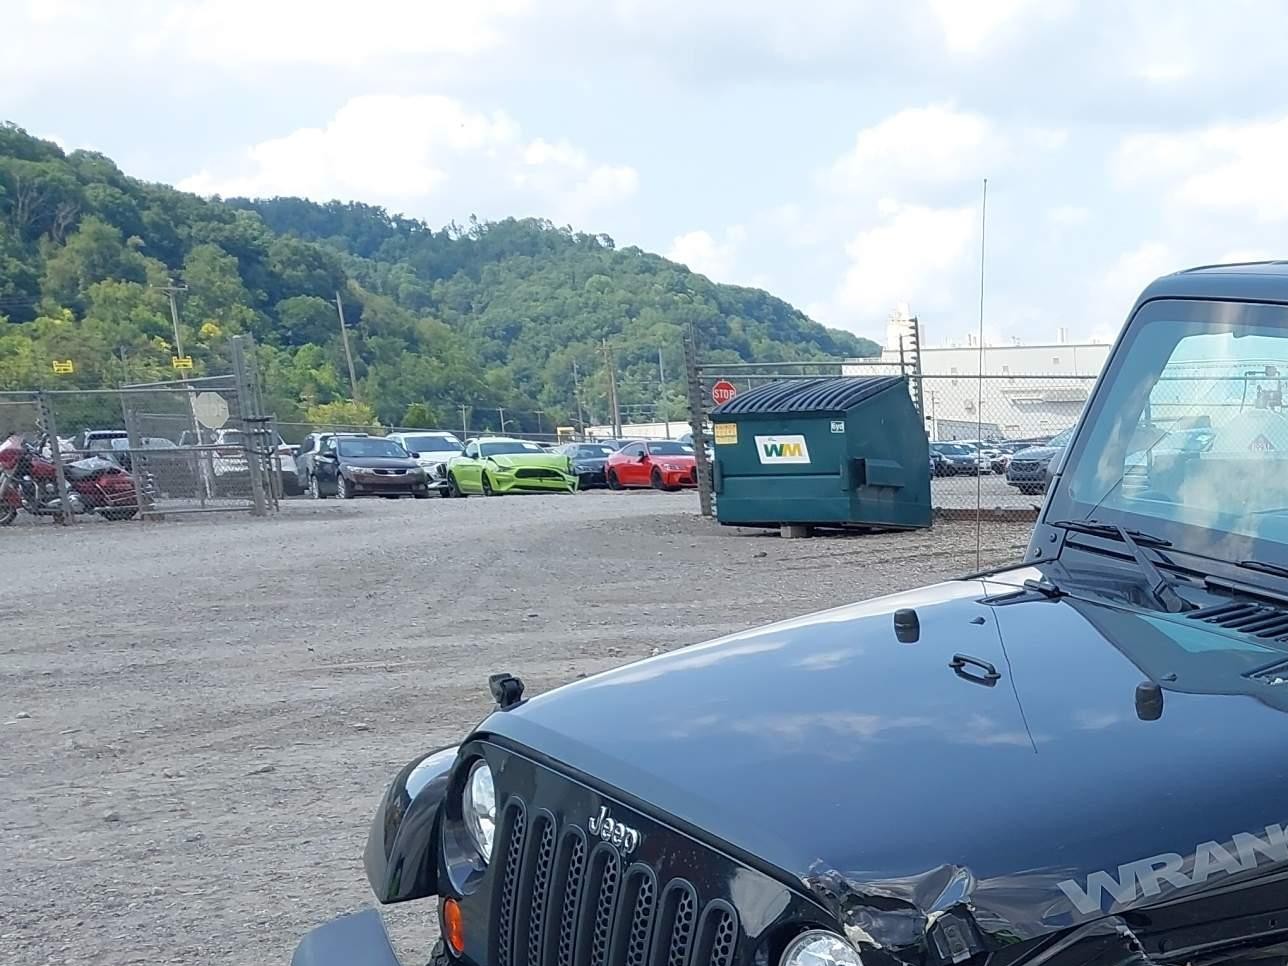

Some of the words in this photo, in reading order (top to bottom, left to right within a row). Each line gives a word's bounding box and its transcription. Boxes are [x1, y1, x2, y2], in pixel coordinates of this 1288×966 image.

[714, 390, 735, 399] STOP
[763, 442, 803, 458] WM
[588, 806, 641, 857] Jeep
